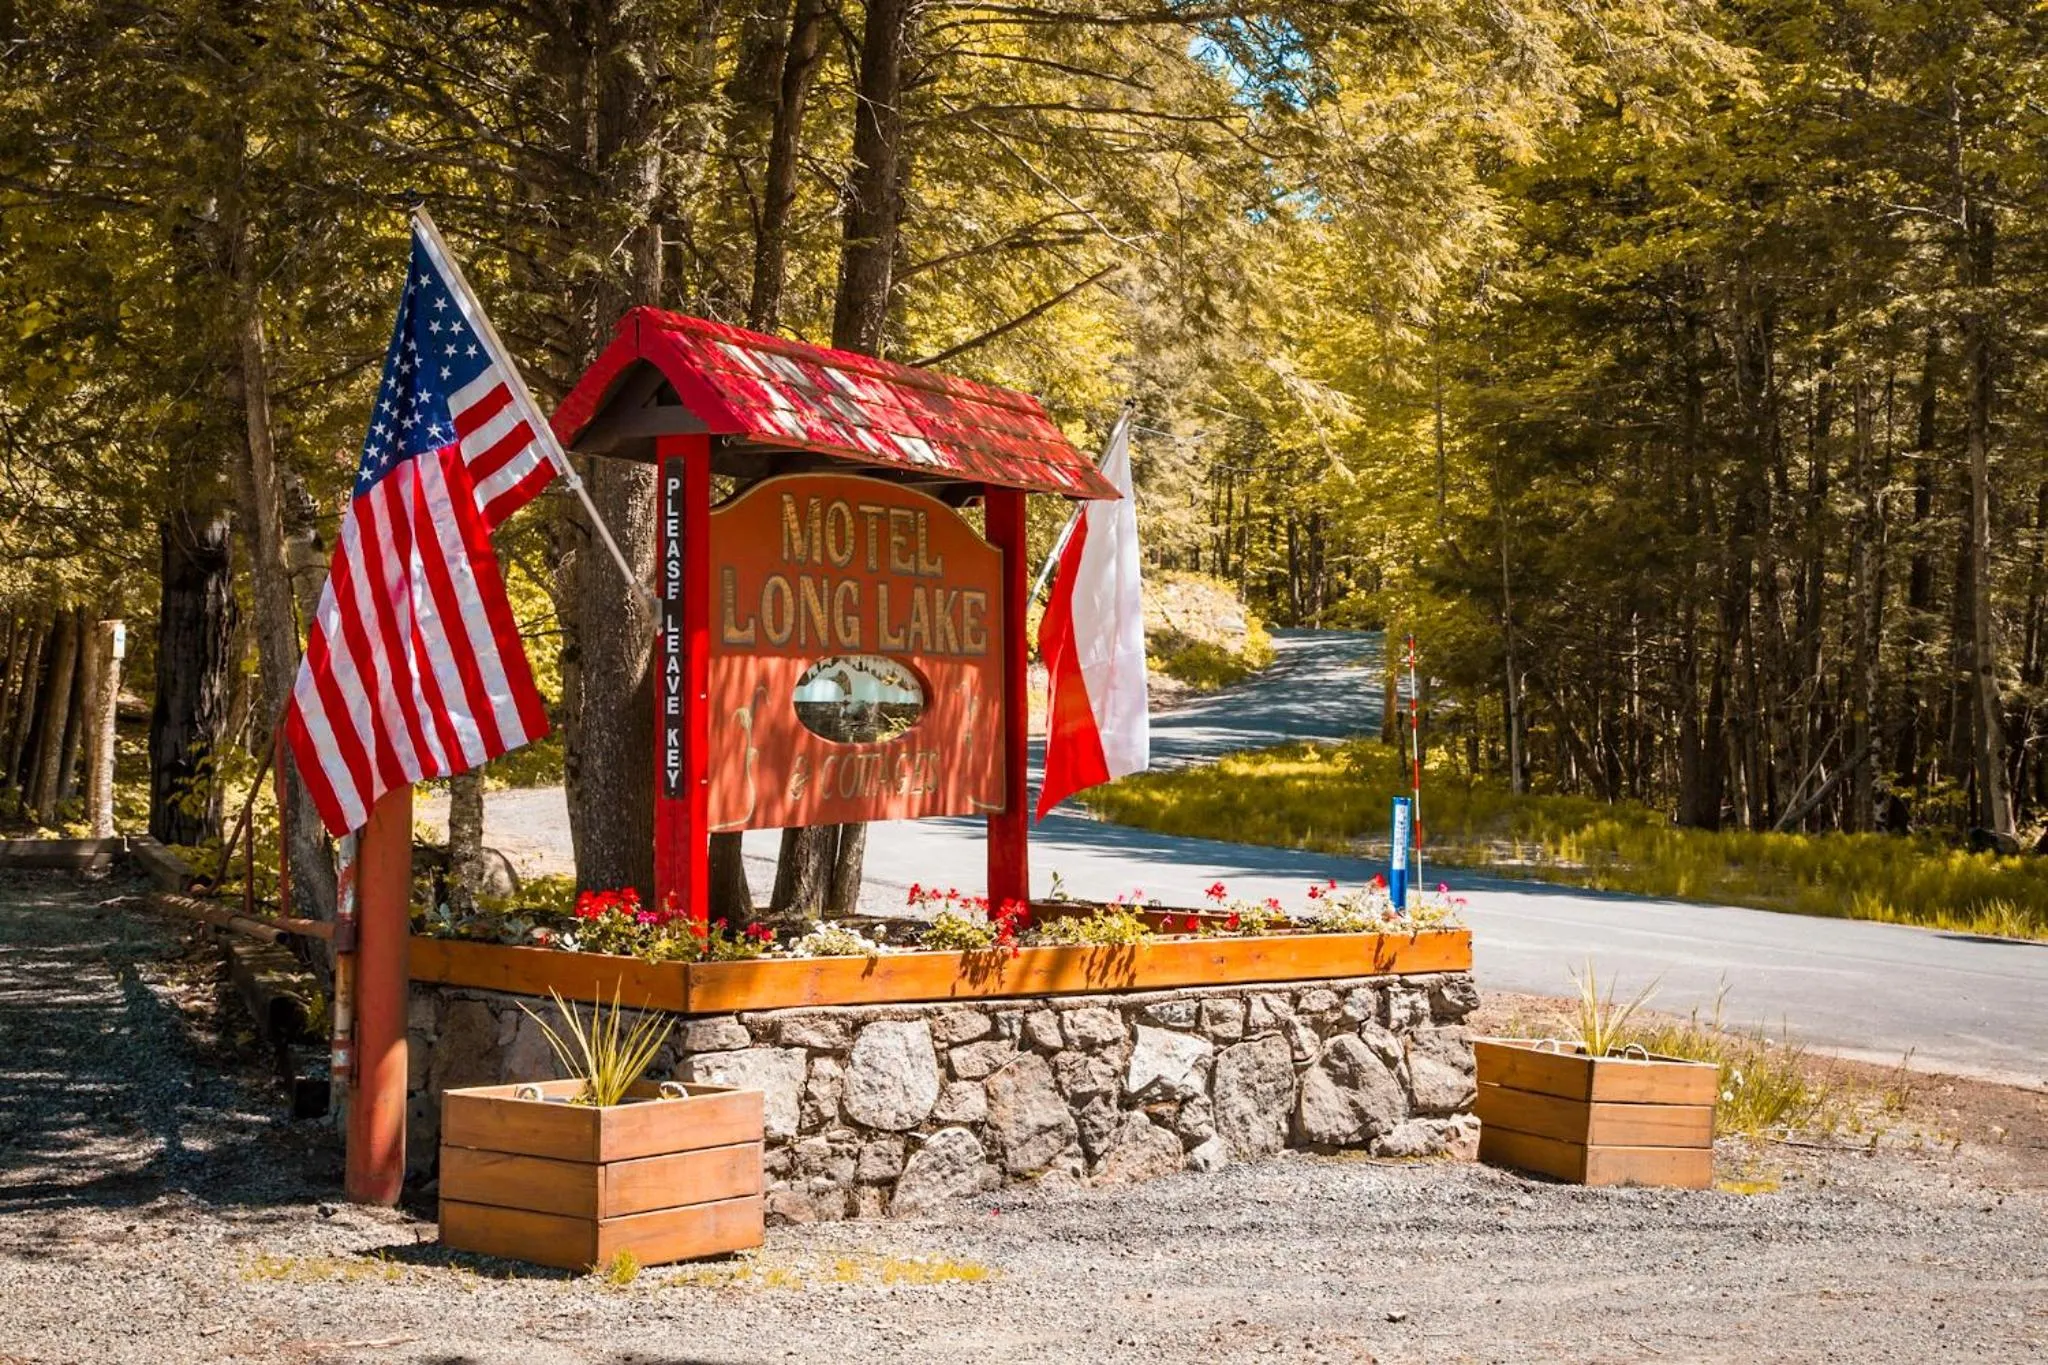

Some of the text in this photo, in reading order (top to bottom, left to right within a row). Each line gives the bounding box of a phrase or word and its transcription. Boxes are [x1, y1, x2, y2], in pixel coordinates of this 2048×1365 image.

[781, 493, 943, 577] MOTEL
[666, 478, 680, 788] PLEASE LEAVE KEY
[721, 566, 988, 656] LONG LAKE
[791, 751, 940, 800] & COTTAGES
